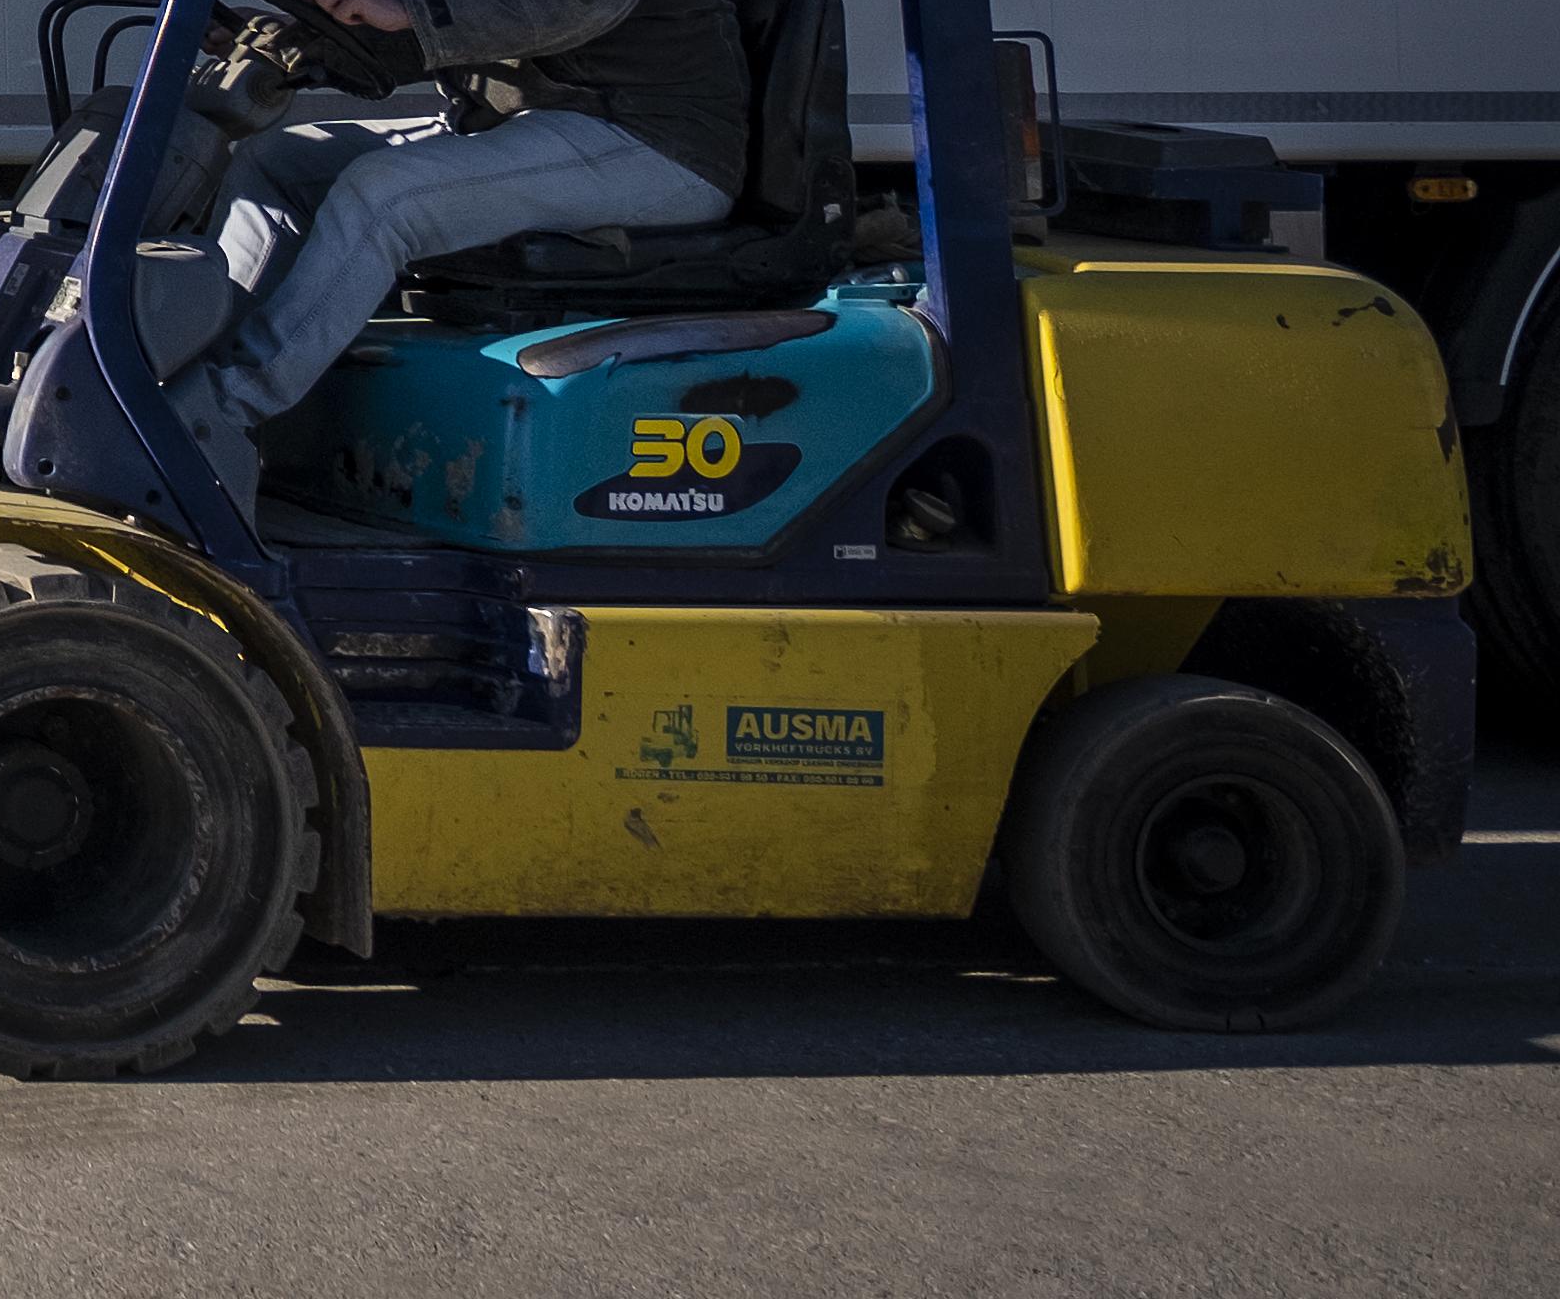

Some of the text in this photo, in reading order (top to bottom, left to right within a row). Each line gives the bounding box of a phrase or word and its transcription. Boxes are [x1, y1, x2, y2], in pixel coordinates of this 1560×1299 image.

[628, 416, 742, 479] 30
[608, 487, 725, 512] KOMATSU
[734, 711, 873, 743] AUSMA
[734, 742, 874, 755] VORKHEFTRUCKS BV
